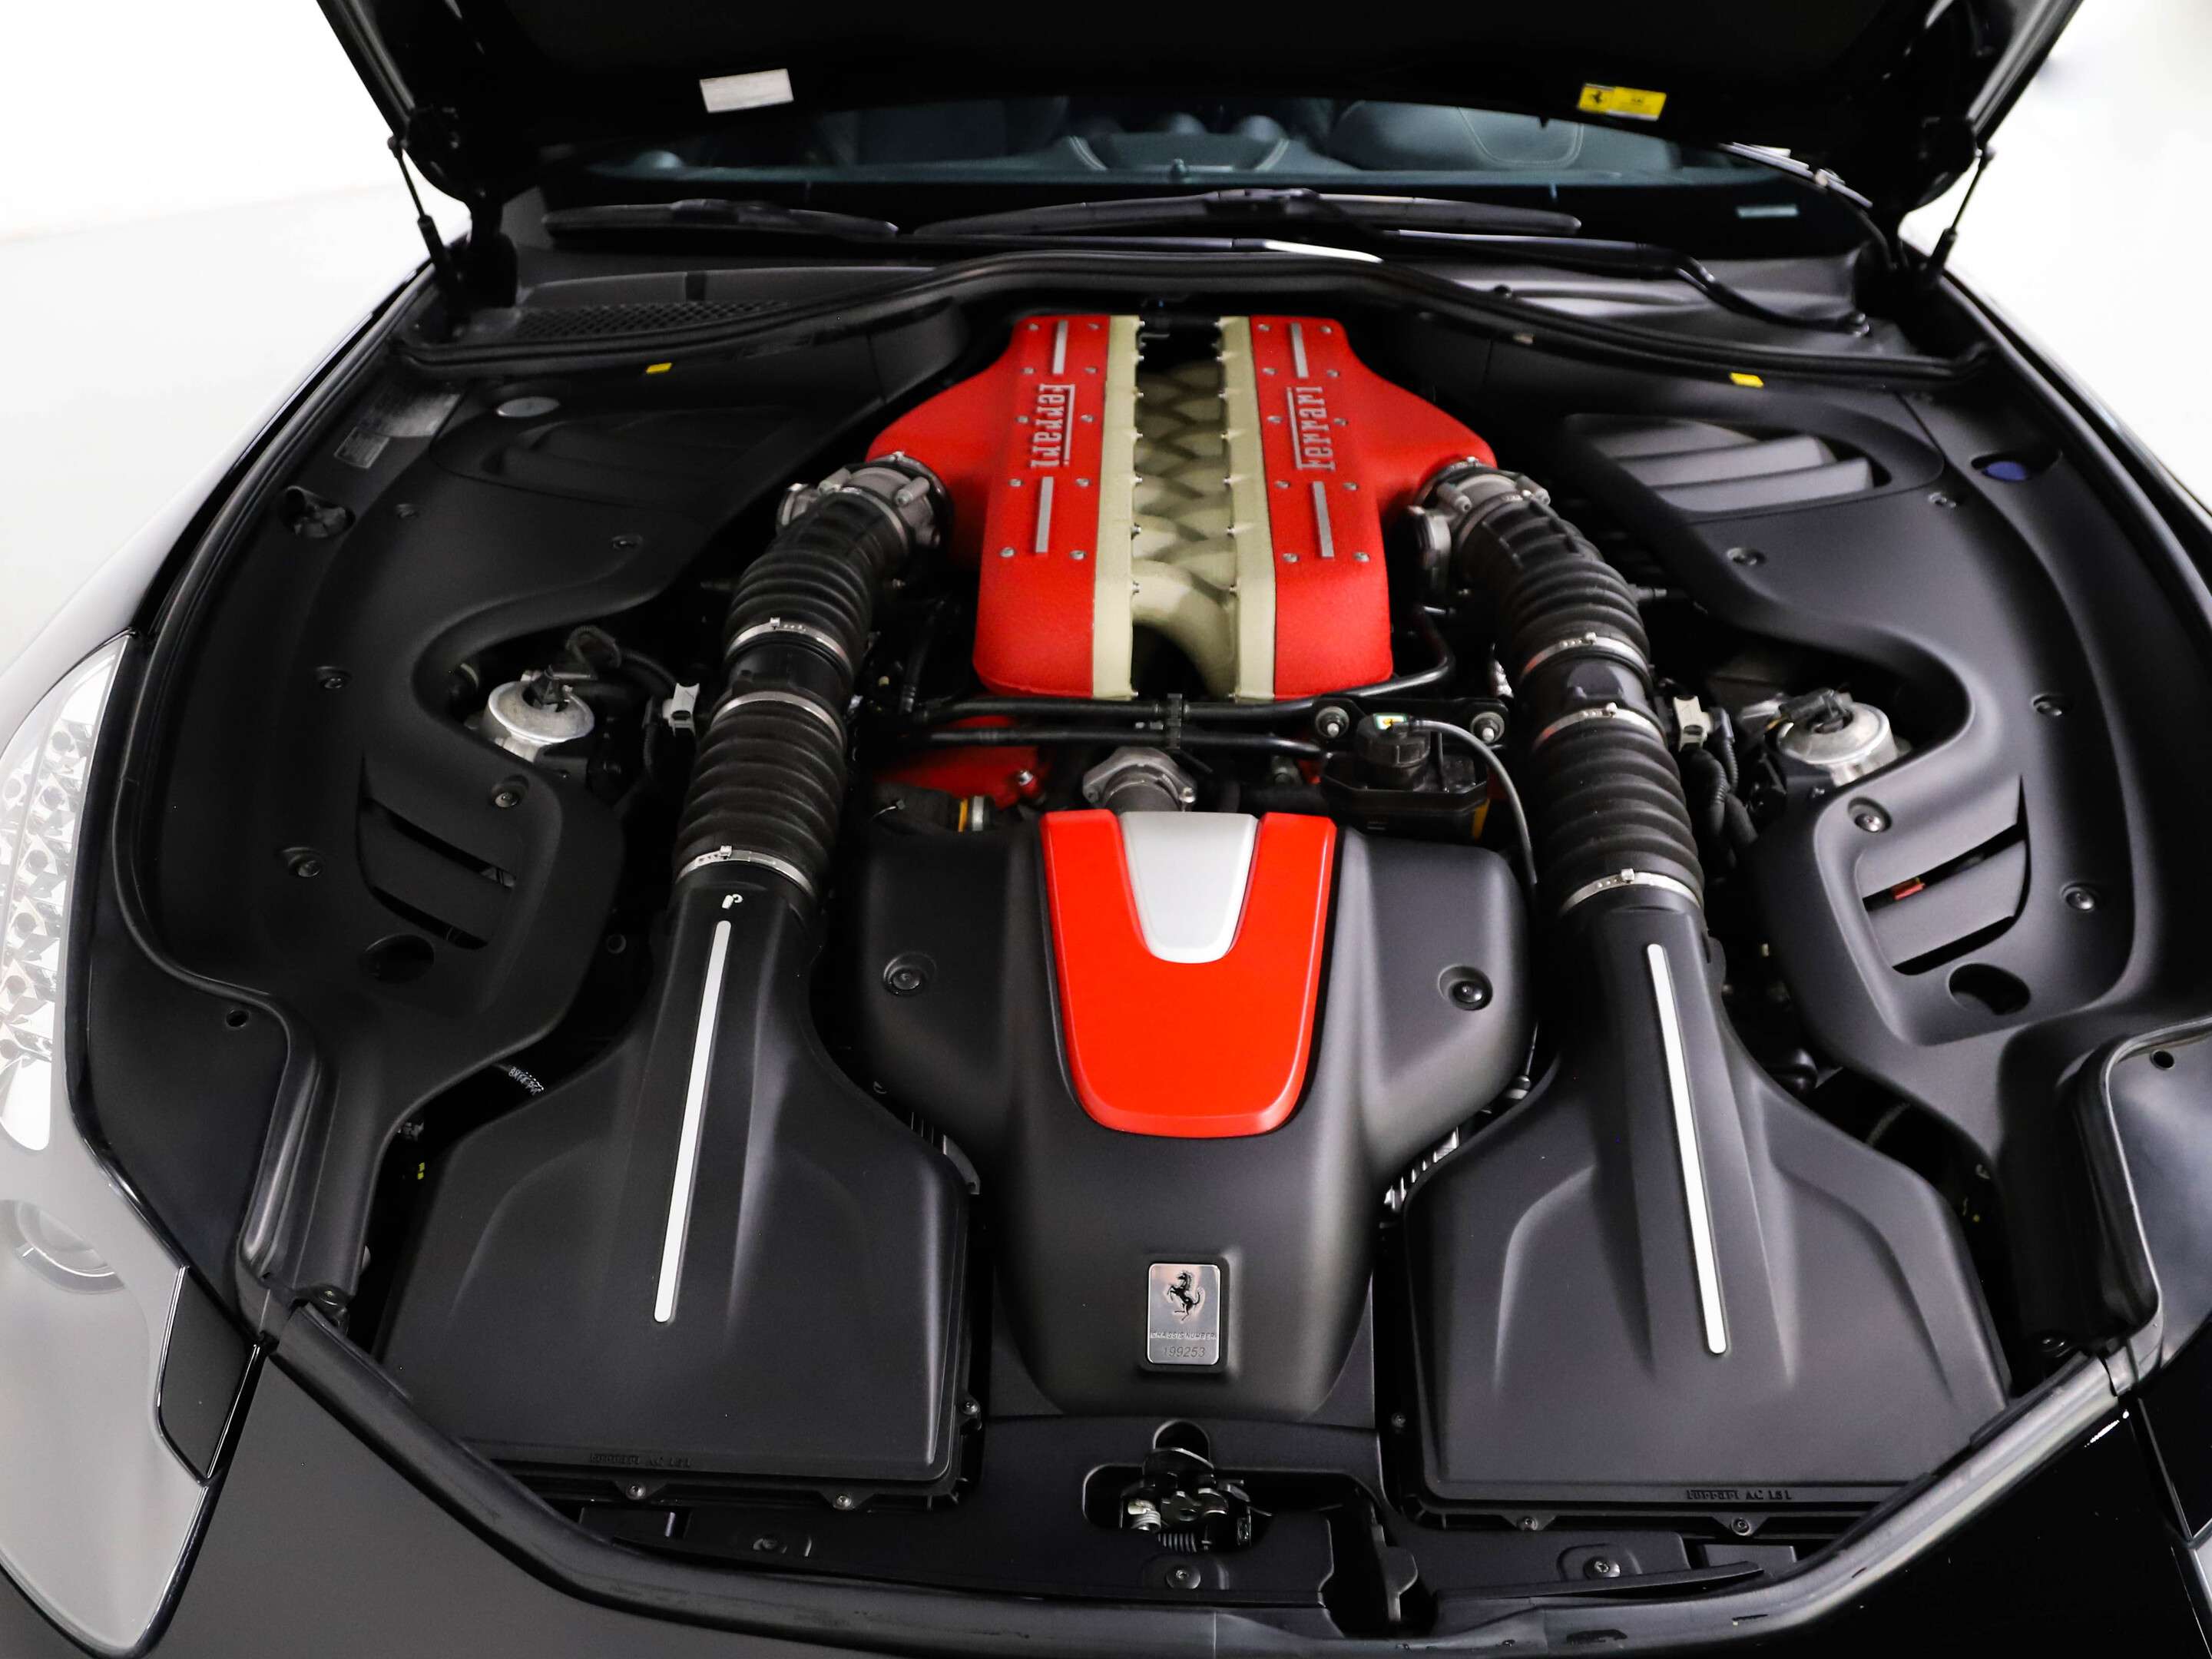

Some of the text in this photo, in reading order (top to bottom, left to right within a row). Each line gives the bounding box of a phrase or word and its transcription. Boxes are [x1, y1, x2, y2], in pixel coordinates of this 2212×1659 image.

[1030, 383, 1075, 469] Ferrari
[1286, 386, 1336, 471] Ferrari
[1164, 1346, 1206, 1358] 199253
